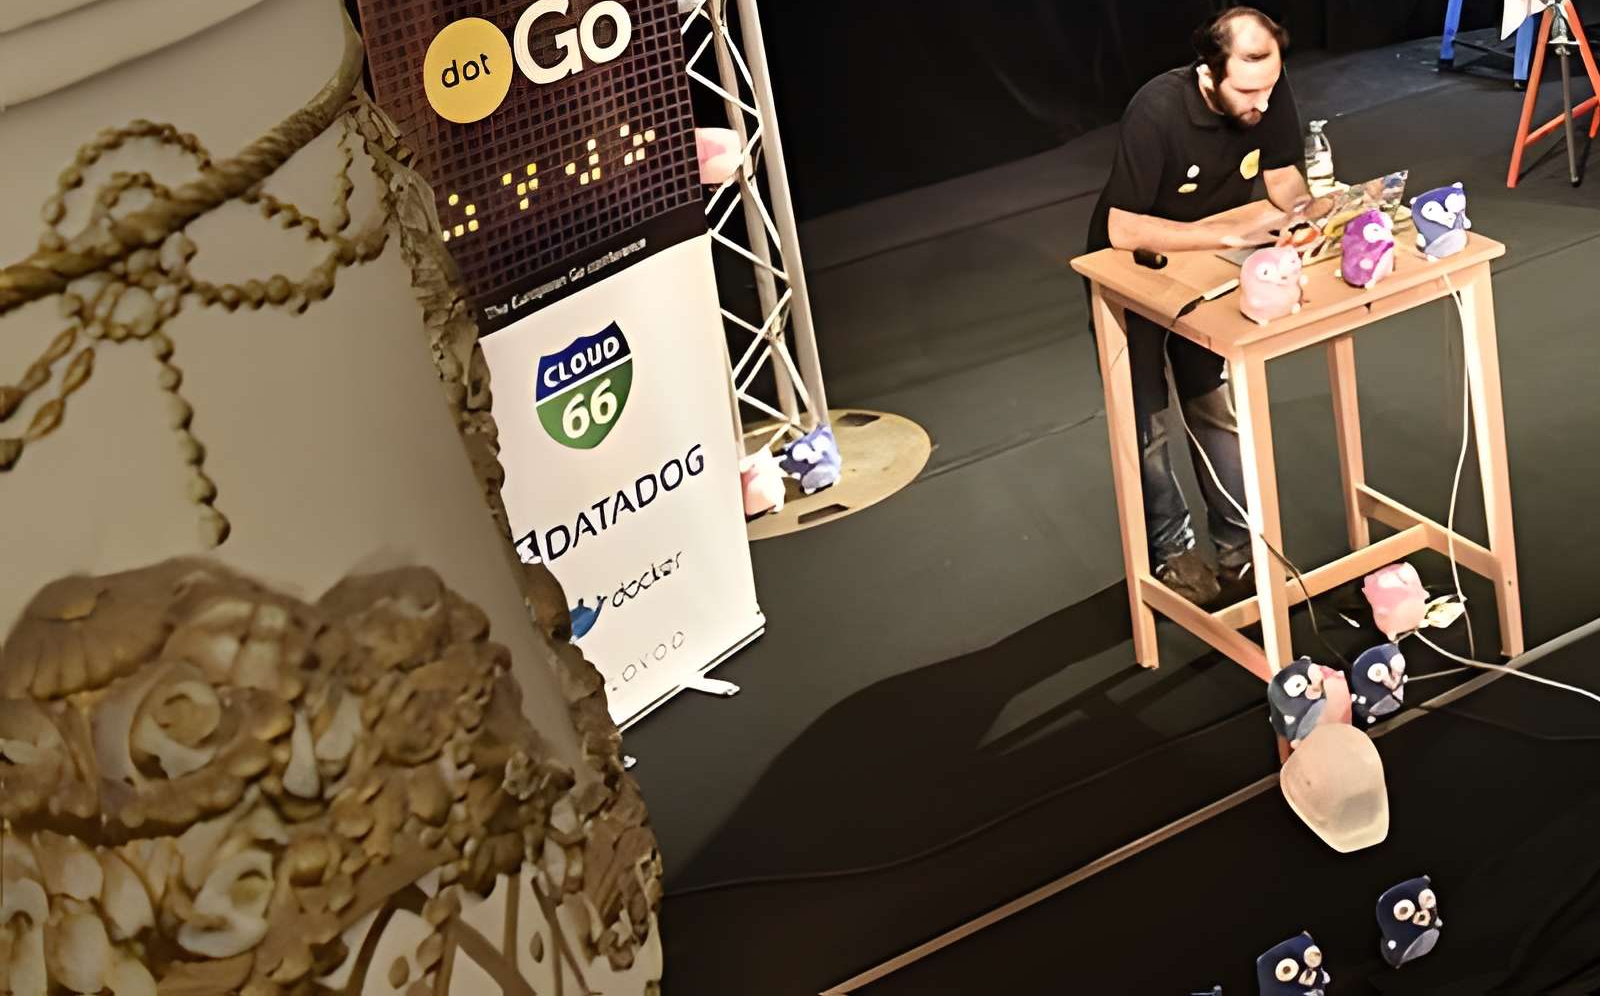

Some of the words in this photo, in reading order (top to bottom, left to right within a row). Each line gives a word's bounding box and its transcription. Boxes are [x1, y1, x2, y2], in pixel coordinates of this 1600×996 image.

[543, 336, 620, 388] CLOUD
[562, 378, 618, 440] 66
[545, 443, 704, 561] DATADOG
[611, 631, 685, 692] OVOO
